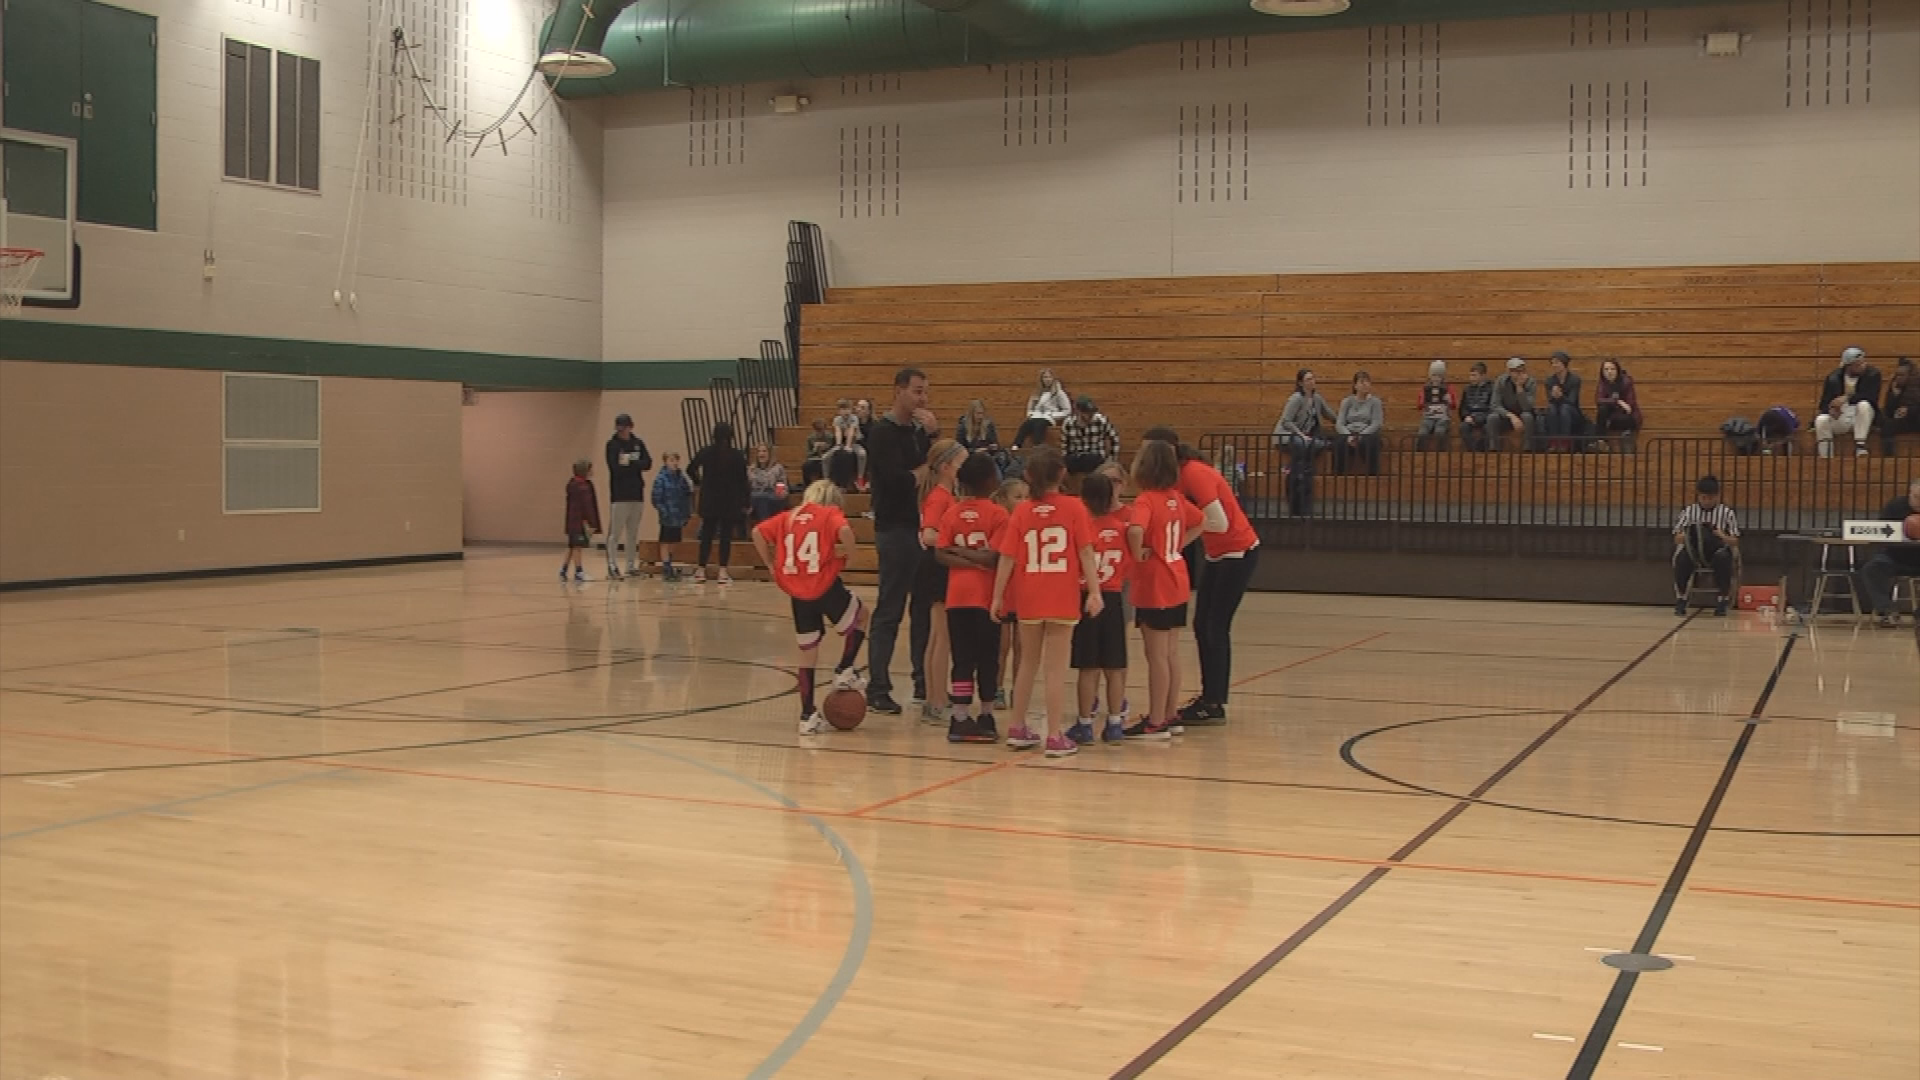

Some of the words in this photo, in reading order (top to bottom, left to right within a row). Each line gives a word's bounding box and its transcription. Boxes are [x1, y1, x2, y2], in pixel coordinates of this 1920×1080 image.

[782, 531, 820, 575] 14
[1024, 526, 1067, 573] 12
[1165, 520, 1184, 563] 11
